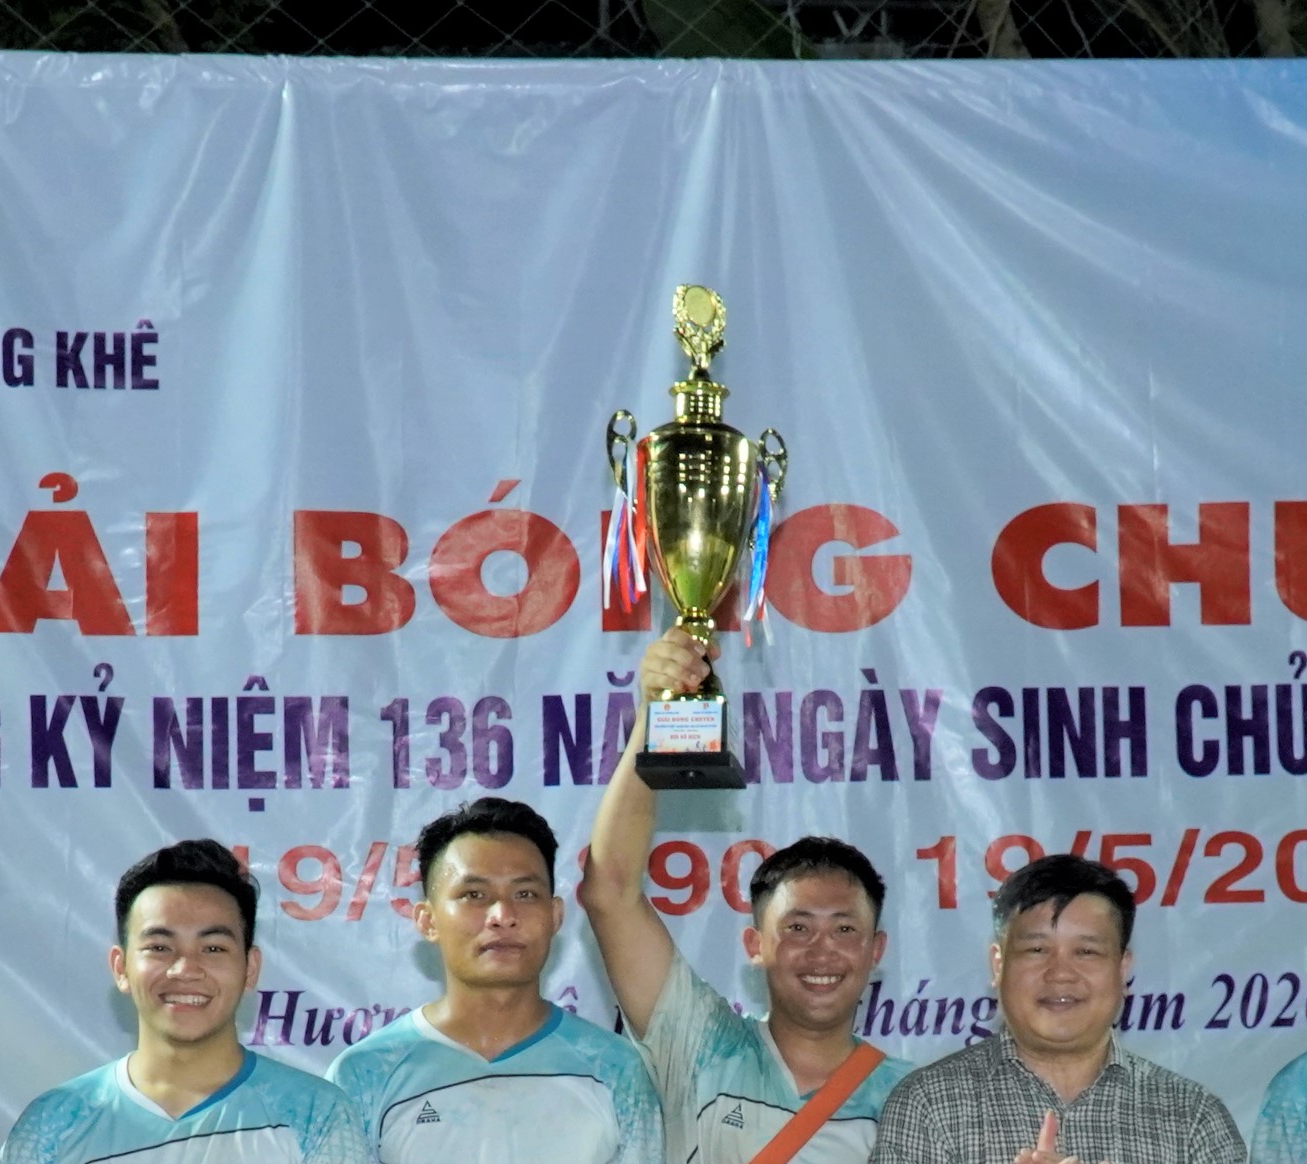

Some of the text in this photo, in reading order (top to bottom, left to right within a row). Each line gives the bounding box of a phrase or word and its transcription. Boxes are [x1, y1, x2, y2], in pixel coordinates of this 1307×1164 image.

[56, 319, 159, 390] KHÊ
[293, 479, 912, 638] BÓG
[30, 662, 126, 790] KỶ
[153, 674, 350, 811] NIỆM
[380, 696, 514, 790] 136
[542, 671, 637, 787] NĂ
[743, 667, 944, 785] NGÀY
[970, 686, 1146, 780] SINH
[852, 979, 998, 1048] háng
